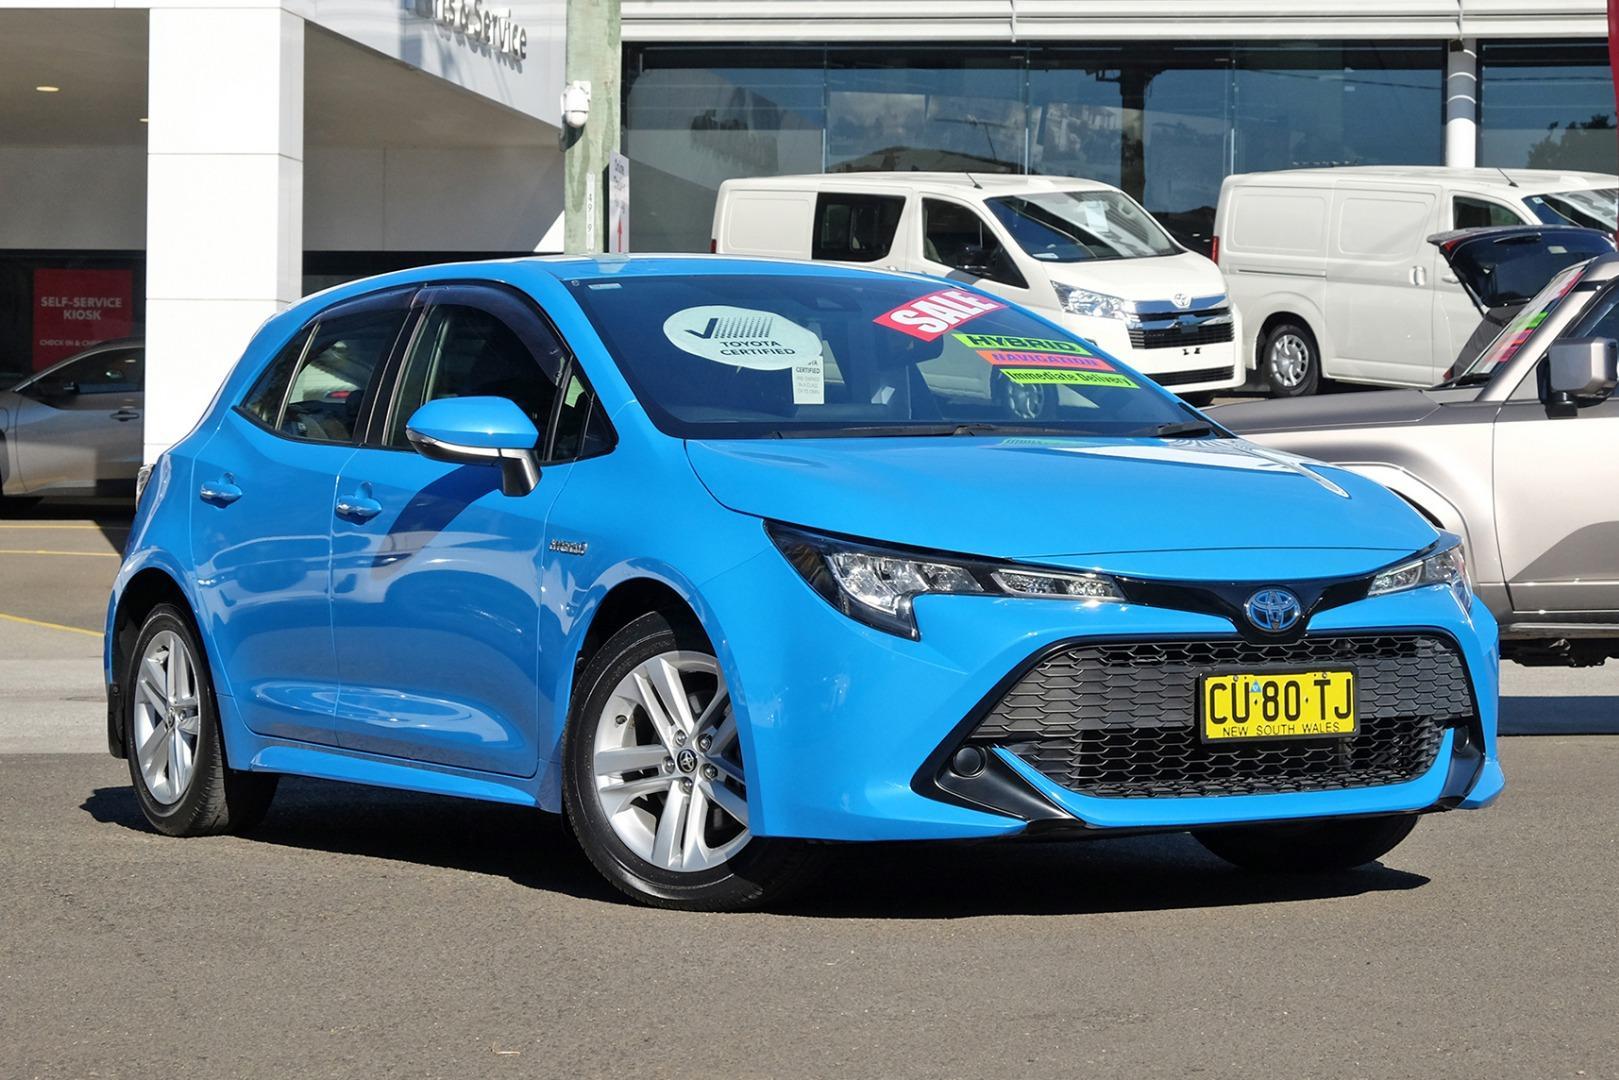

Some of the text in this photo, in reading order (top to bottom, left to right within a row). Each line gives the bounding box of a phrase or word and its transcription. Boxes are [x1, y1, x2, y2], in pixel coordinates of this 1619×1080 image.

[474, 0, 527, 59] Service
[41, 297, 122, 308] SELF-SERVICE
[63, 310, 101, 320] KIOSK
[890, 290, 999, 333] SALE
[966, 335, 1081, 352] HYBRID
[720, 348, 796, 356] CERTIFIED
[992, 353, 1097, 366] NAVIGATION
[1005, 371, 1132, 386] Immediate Delivery
[1222, 722, 1340, 737] NEW SOUTH WALES
